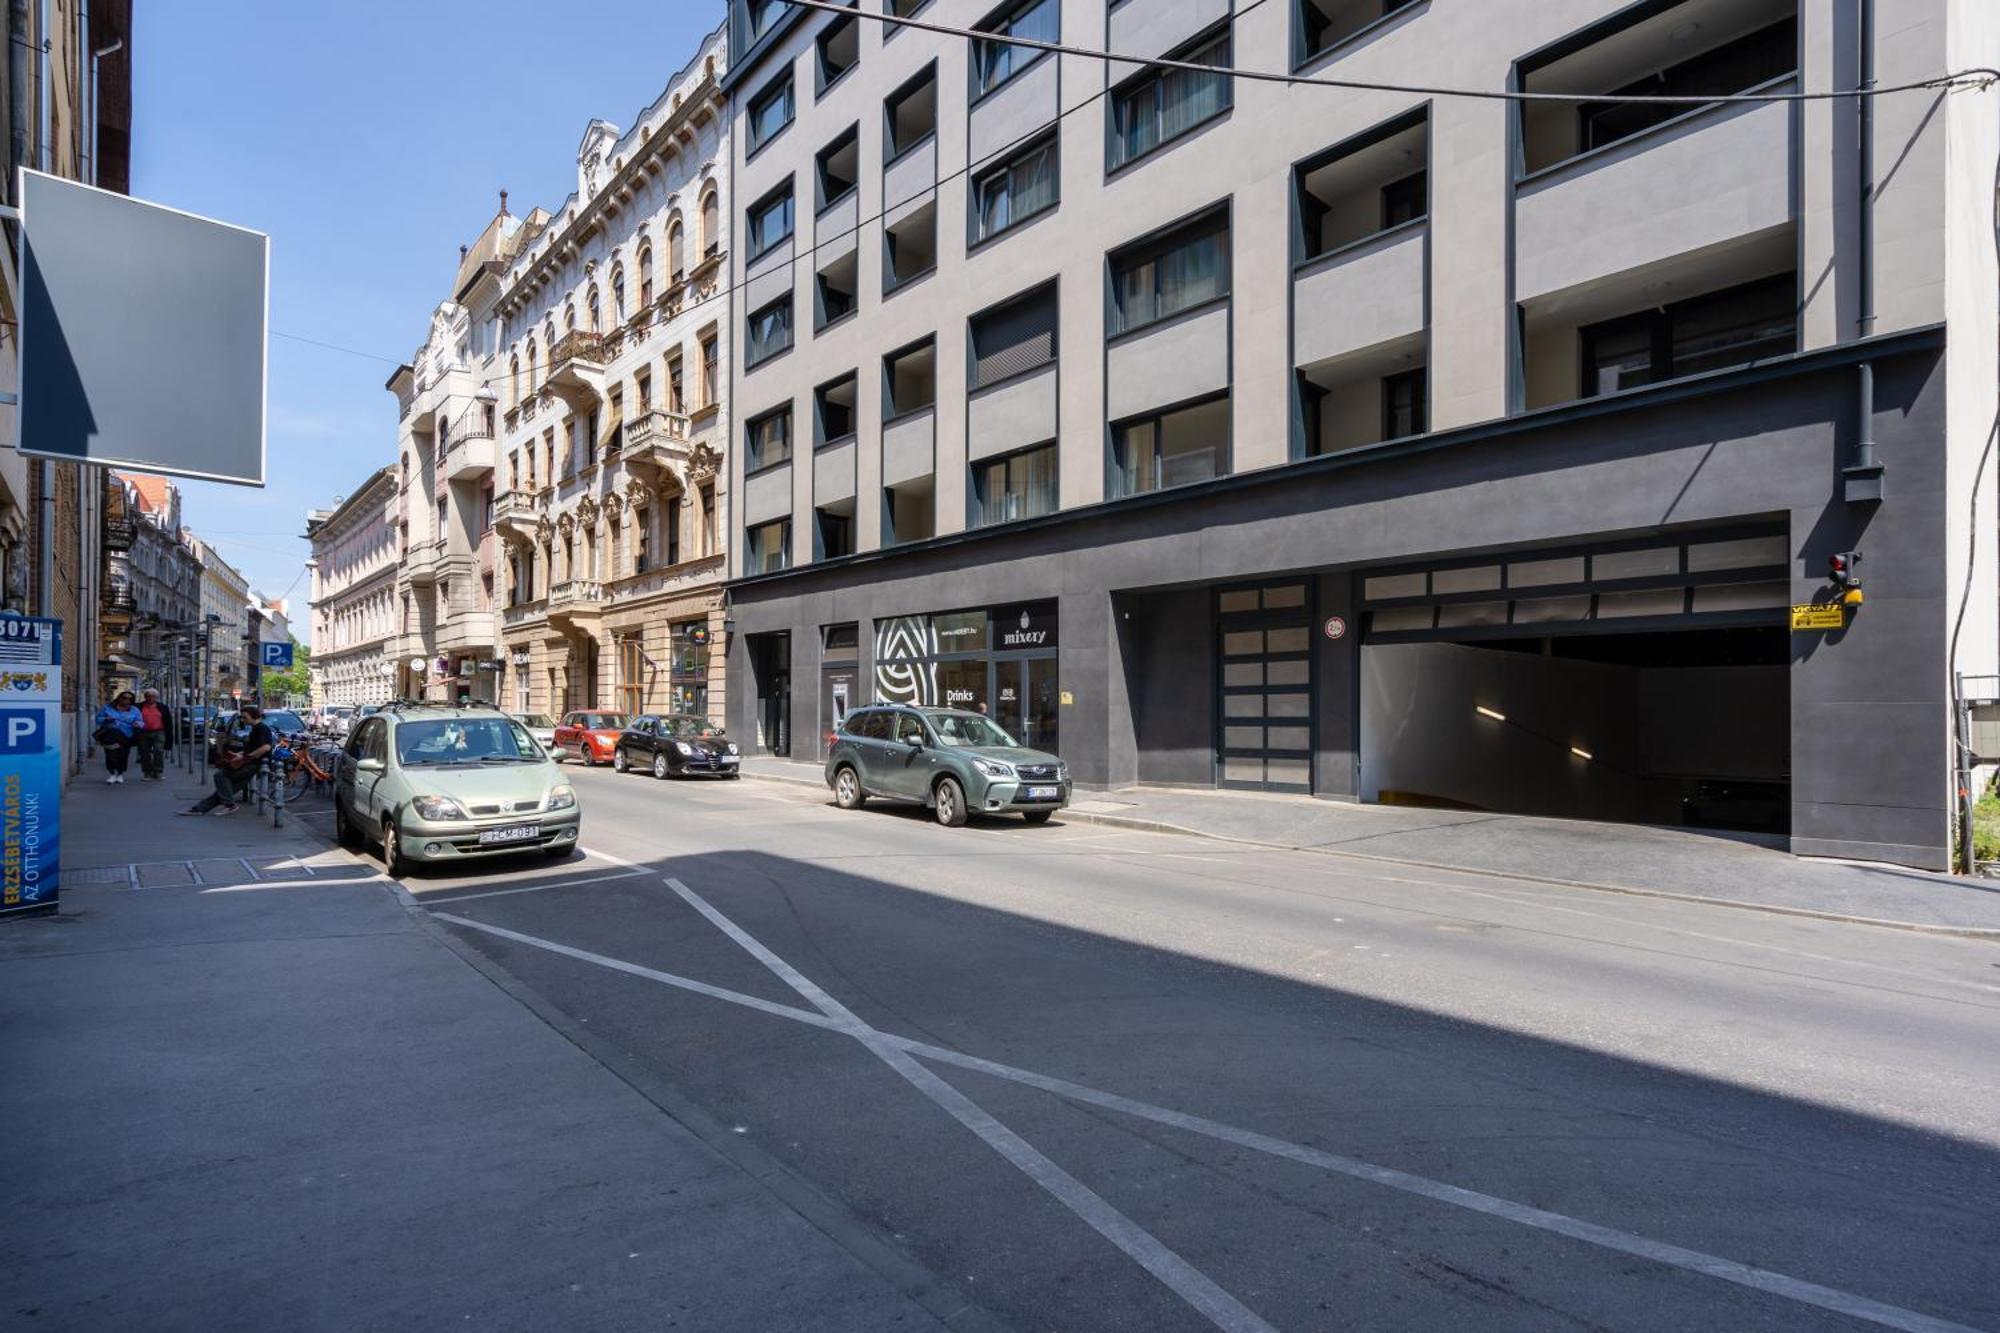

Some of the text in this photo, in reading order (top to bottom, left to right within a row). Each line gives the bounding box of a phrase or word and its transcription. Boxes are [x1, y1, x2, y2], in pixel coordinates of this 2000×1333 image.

[1004, 630, 1046, 645] mixery
[266, 644, 282, 663] P
[947, 690, 973, 701] Drinks
[8, 717, 37, 747] P
[5, 774, 20, 905] ERZSÉBETVÁROS
[25, 793, 39, 901] AZ OTTHONUNK!
